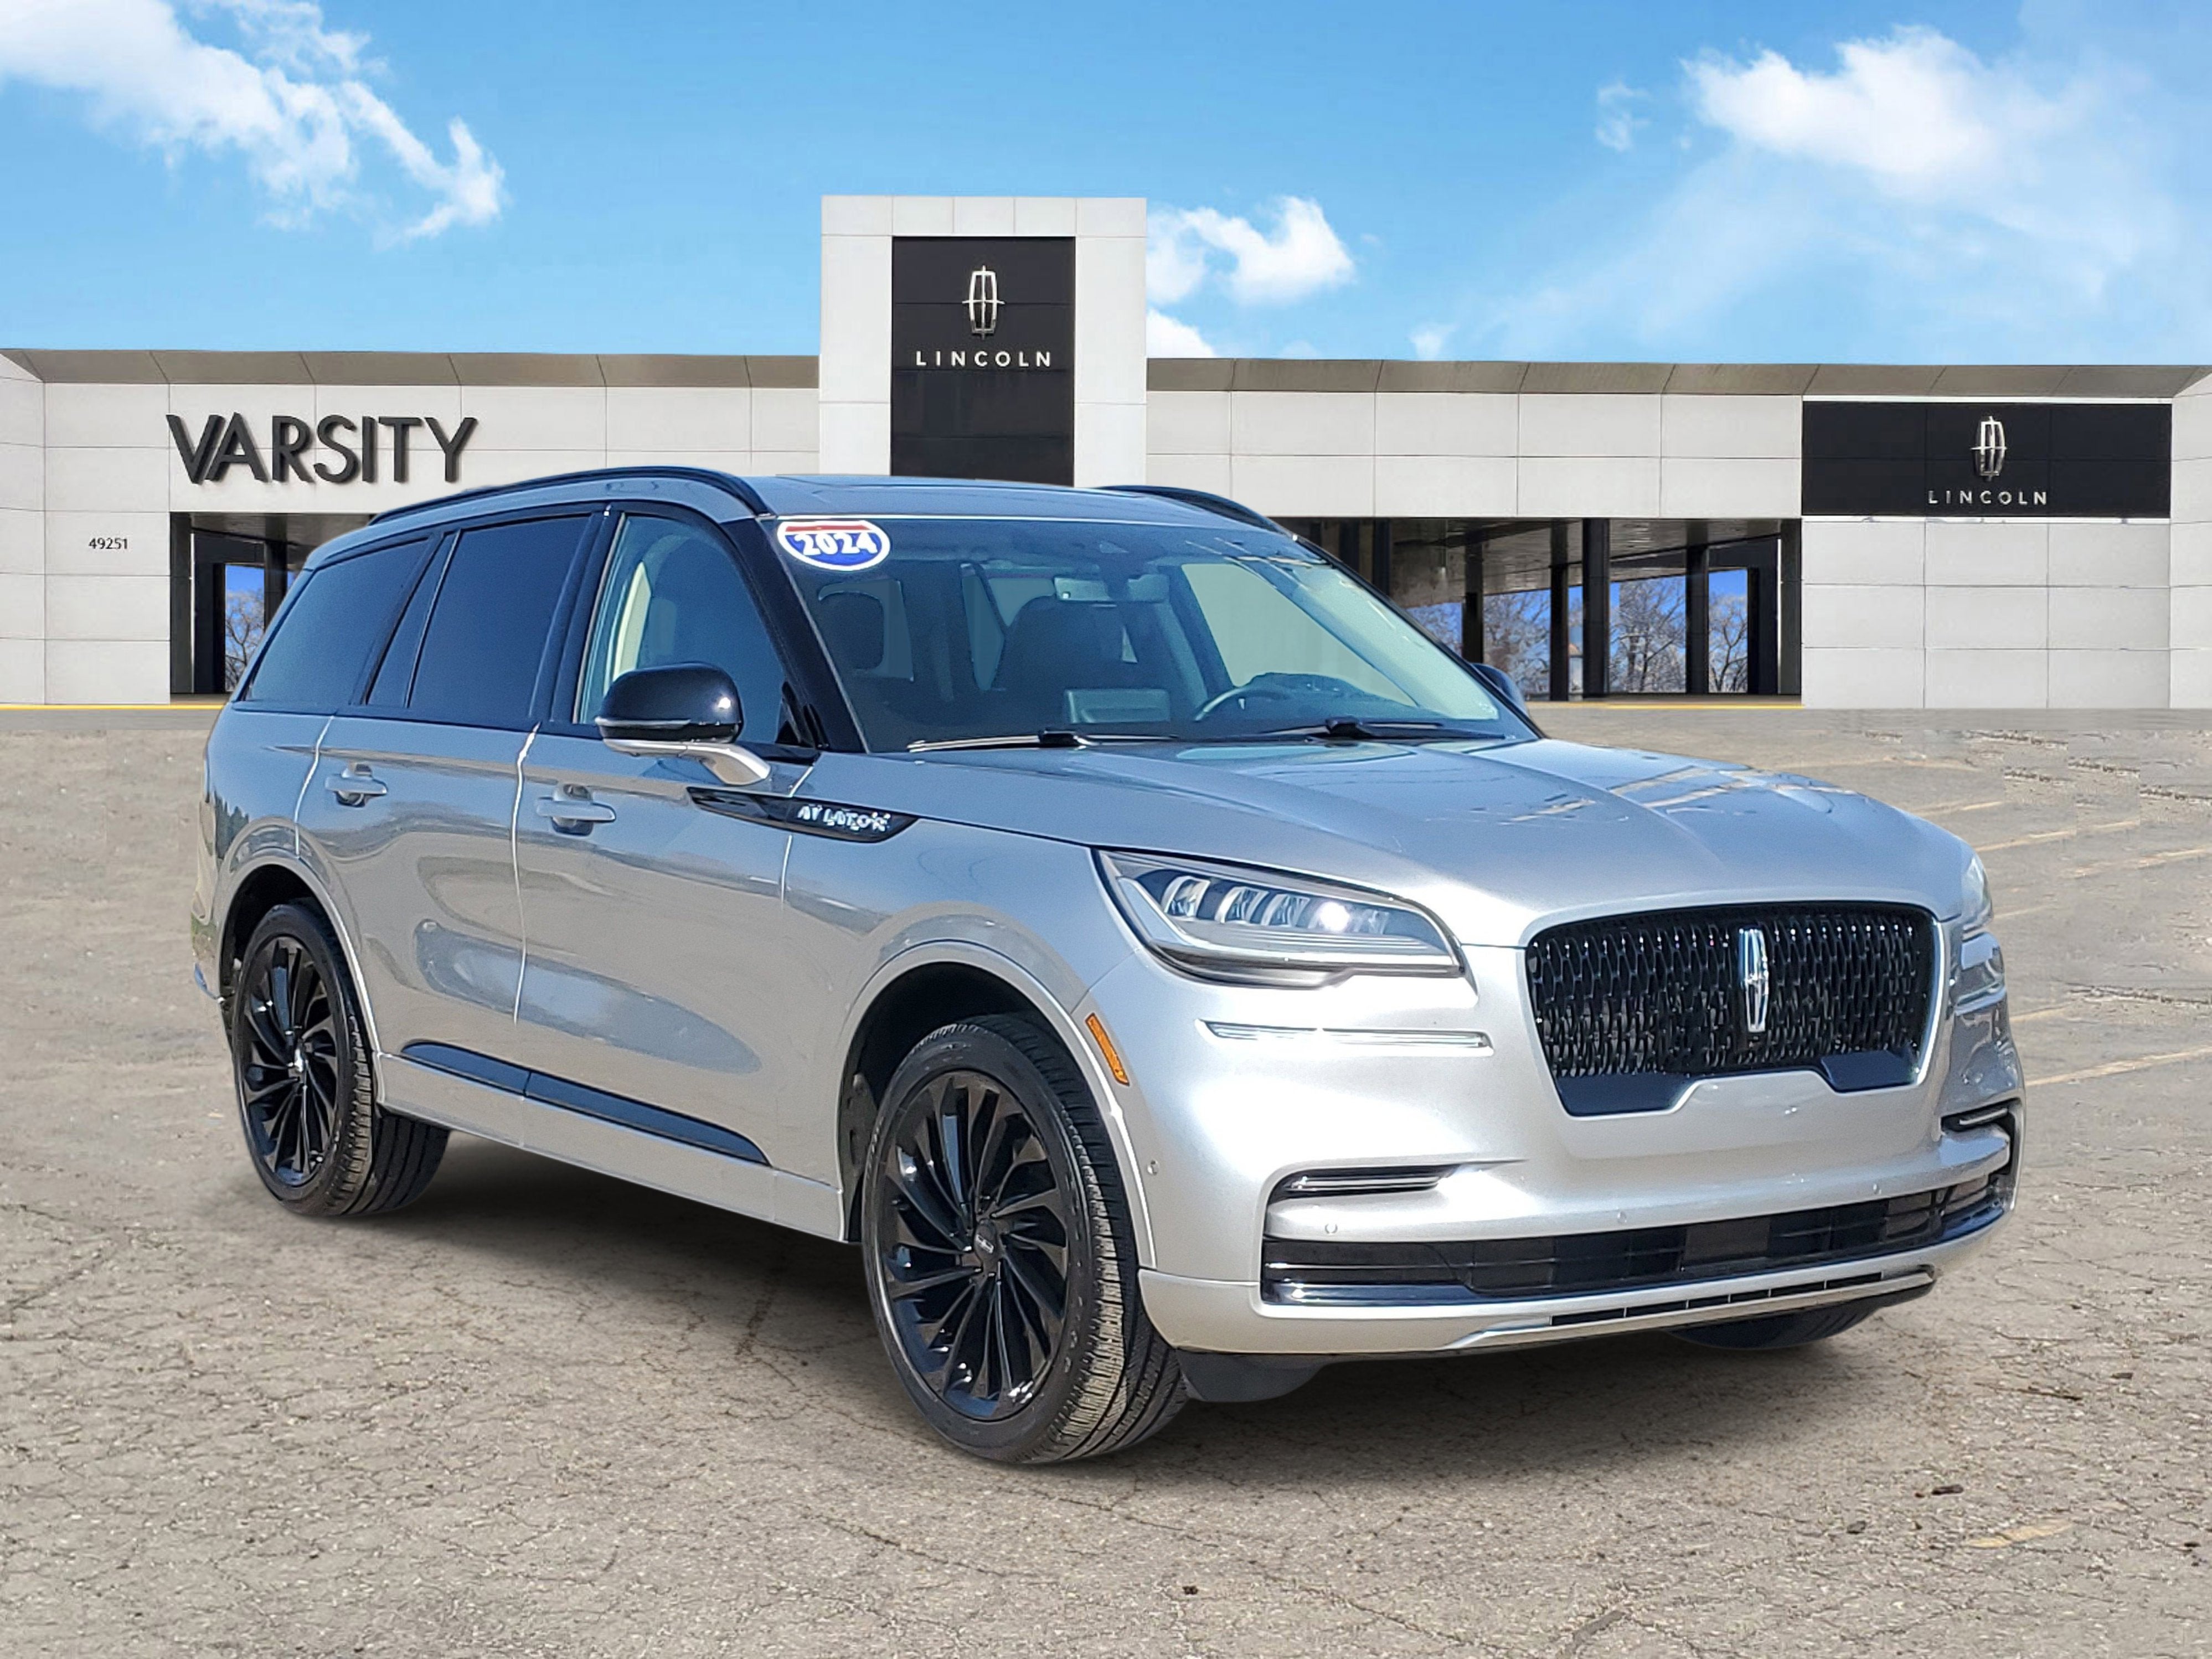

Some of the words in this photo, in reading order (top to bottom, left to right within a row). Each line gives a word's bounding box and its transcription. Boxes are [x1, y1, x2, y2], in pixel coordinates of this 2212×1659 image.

[916, 351, 1050, 367] LINCOLN
[166, 413, 477, 484] VARSITY
[1929, 491, 2047, 505] LINCOLN
[89, 538, 128, 549] 49251
[794, 533, 878, 555] 2024
